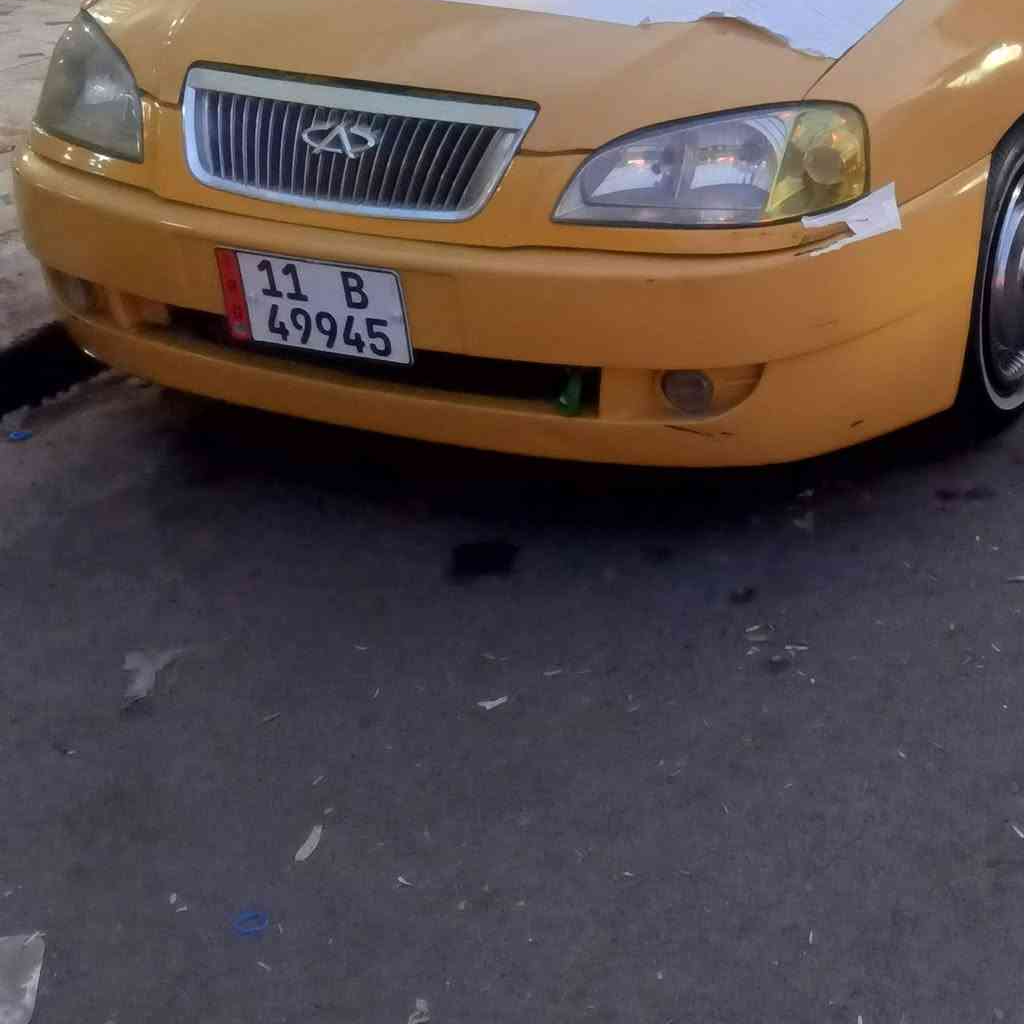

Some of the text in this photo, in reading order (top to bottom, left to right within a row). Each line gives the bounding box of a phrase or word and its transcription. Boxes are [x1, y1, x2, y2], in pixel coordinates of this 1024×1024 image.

[257, 259, 308, 302] 11
[340, 271, 369, 309] B
[268, 304, 392, 357] 49945
